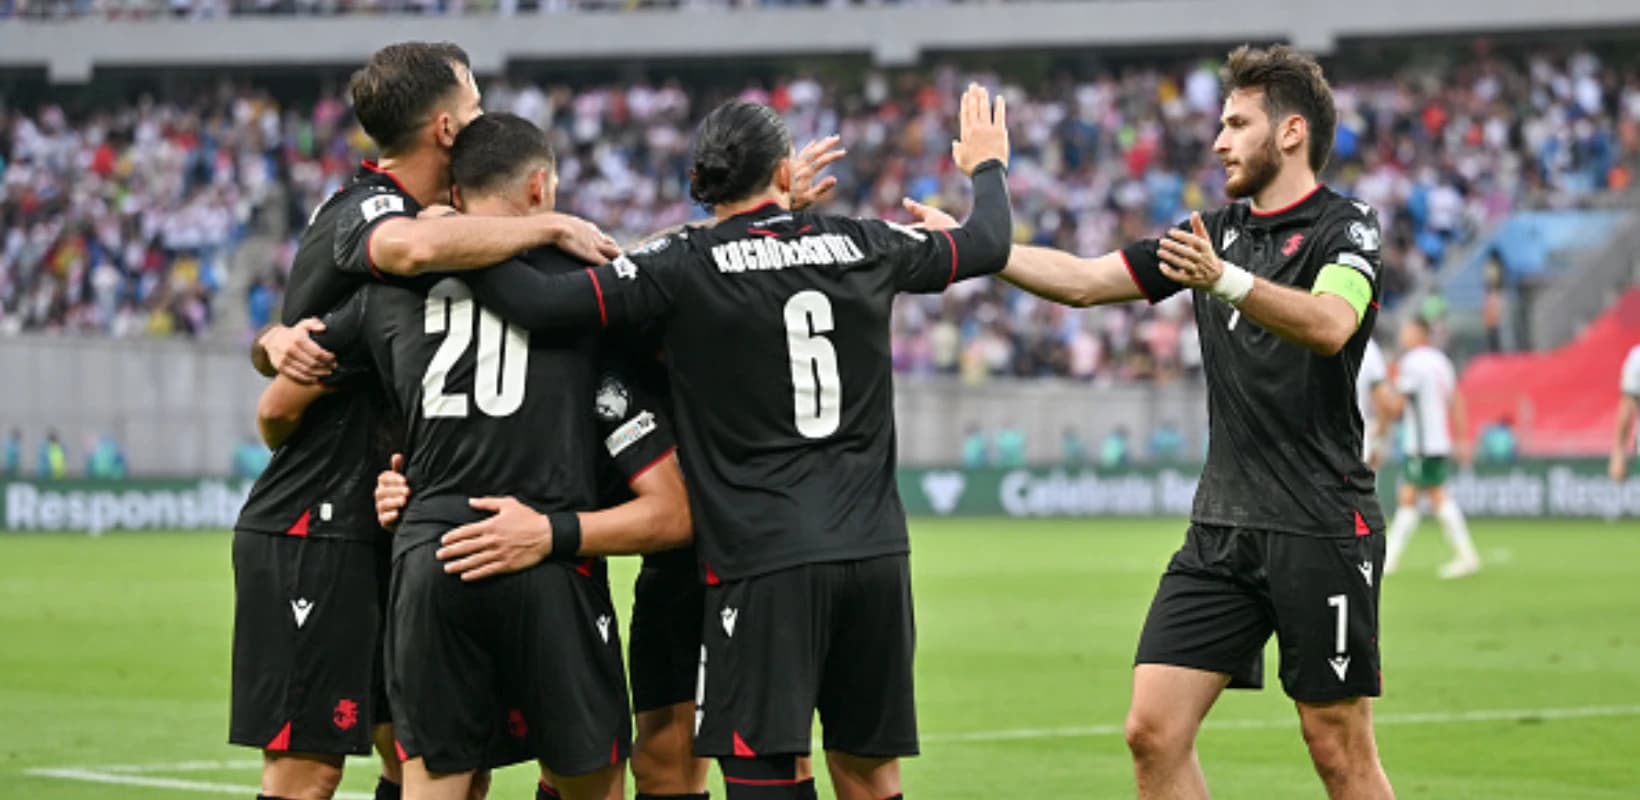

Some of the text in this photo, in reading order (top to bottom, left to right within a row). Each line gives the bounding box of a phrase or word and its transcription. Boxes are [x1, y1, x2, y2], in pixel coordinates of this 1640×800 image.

[422, 277, 529, 418] 20
[784, 289, 842, 439] 6
[998, 469, 1154, 516] Celebrate
